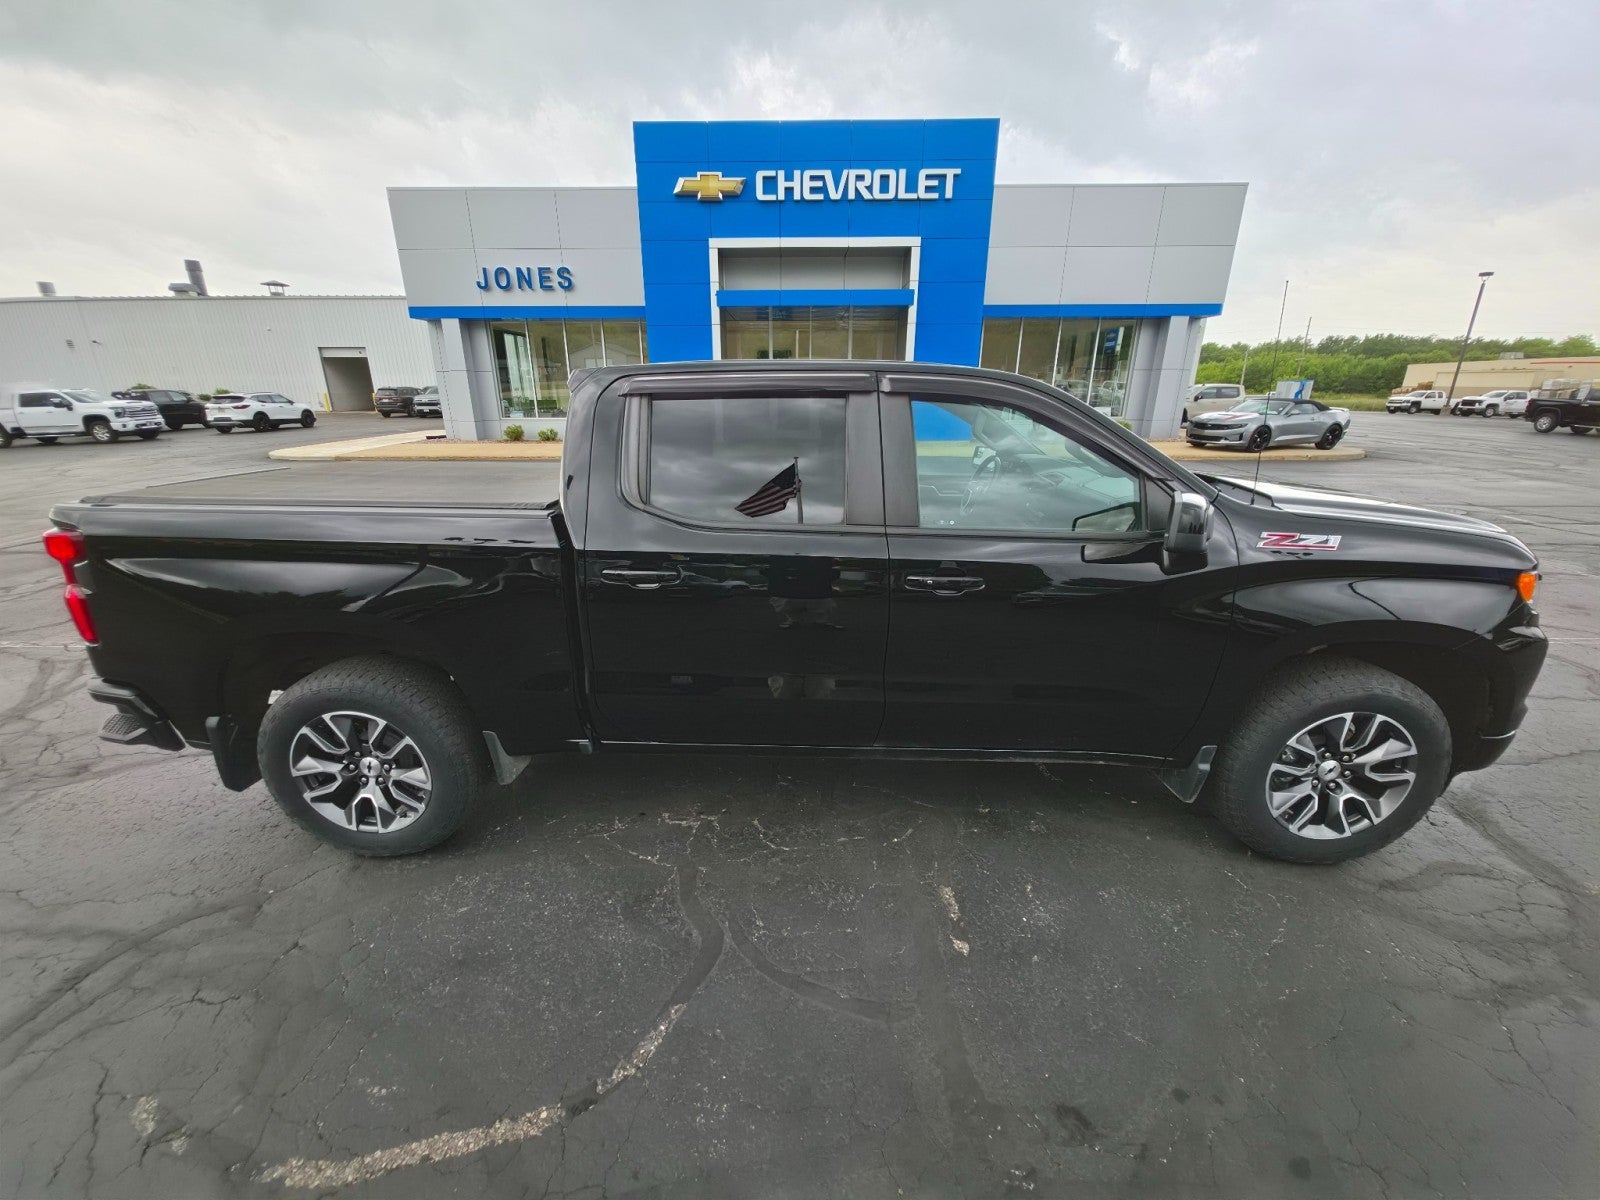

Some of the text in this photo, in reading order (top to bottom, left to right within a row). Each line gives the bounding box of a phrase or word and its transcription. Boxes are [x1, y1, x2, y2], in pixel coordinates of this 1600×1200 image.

[755, 168, 962, 201] CHEVROLET
[476, 266, 574, 291] JONES
[1256, 531, 1342, 551] Z71
